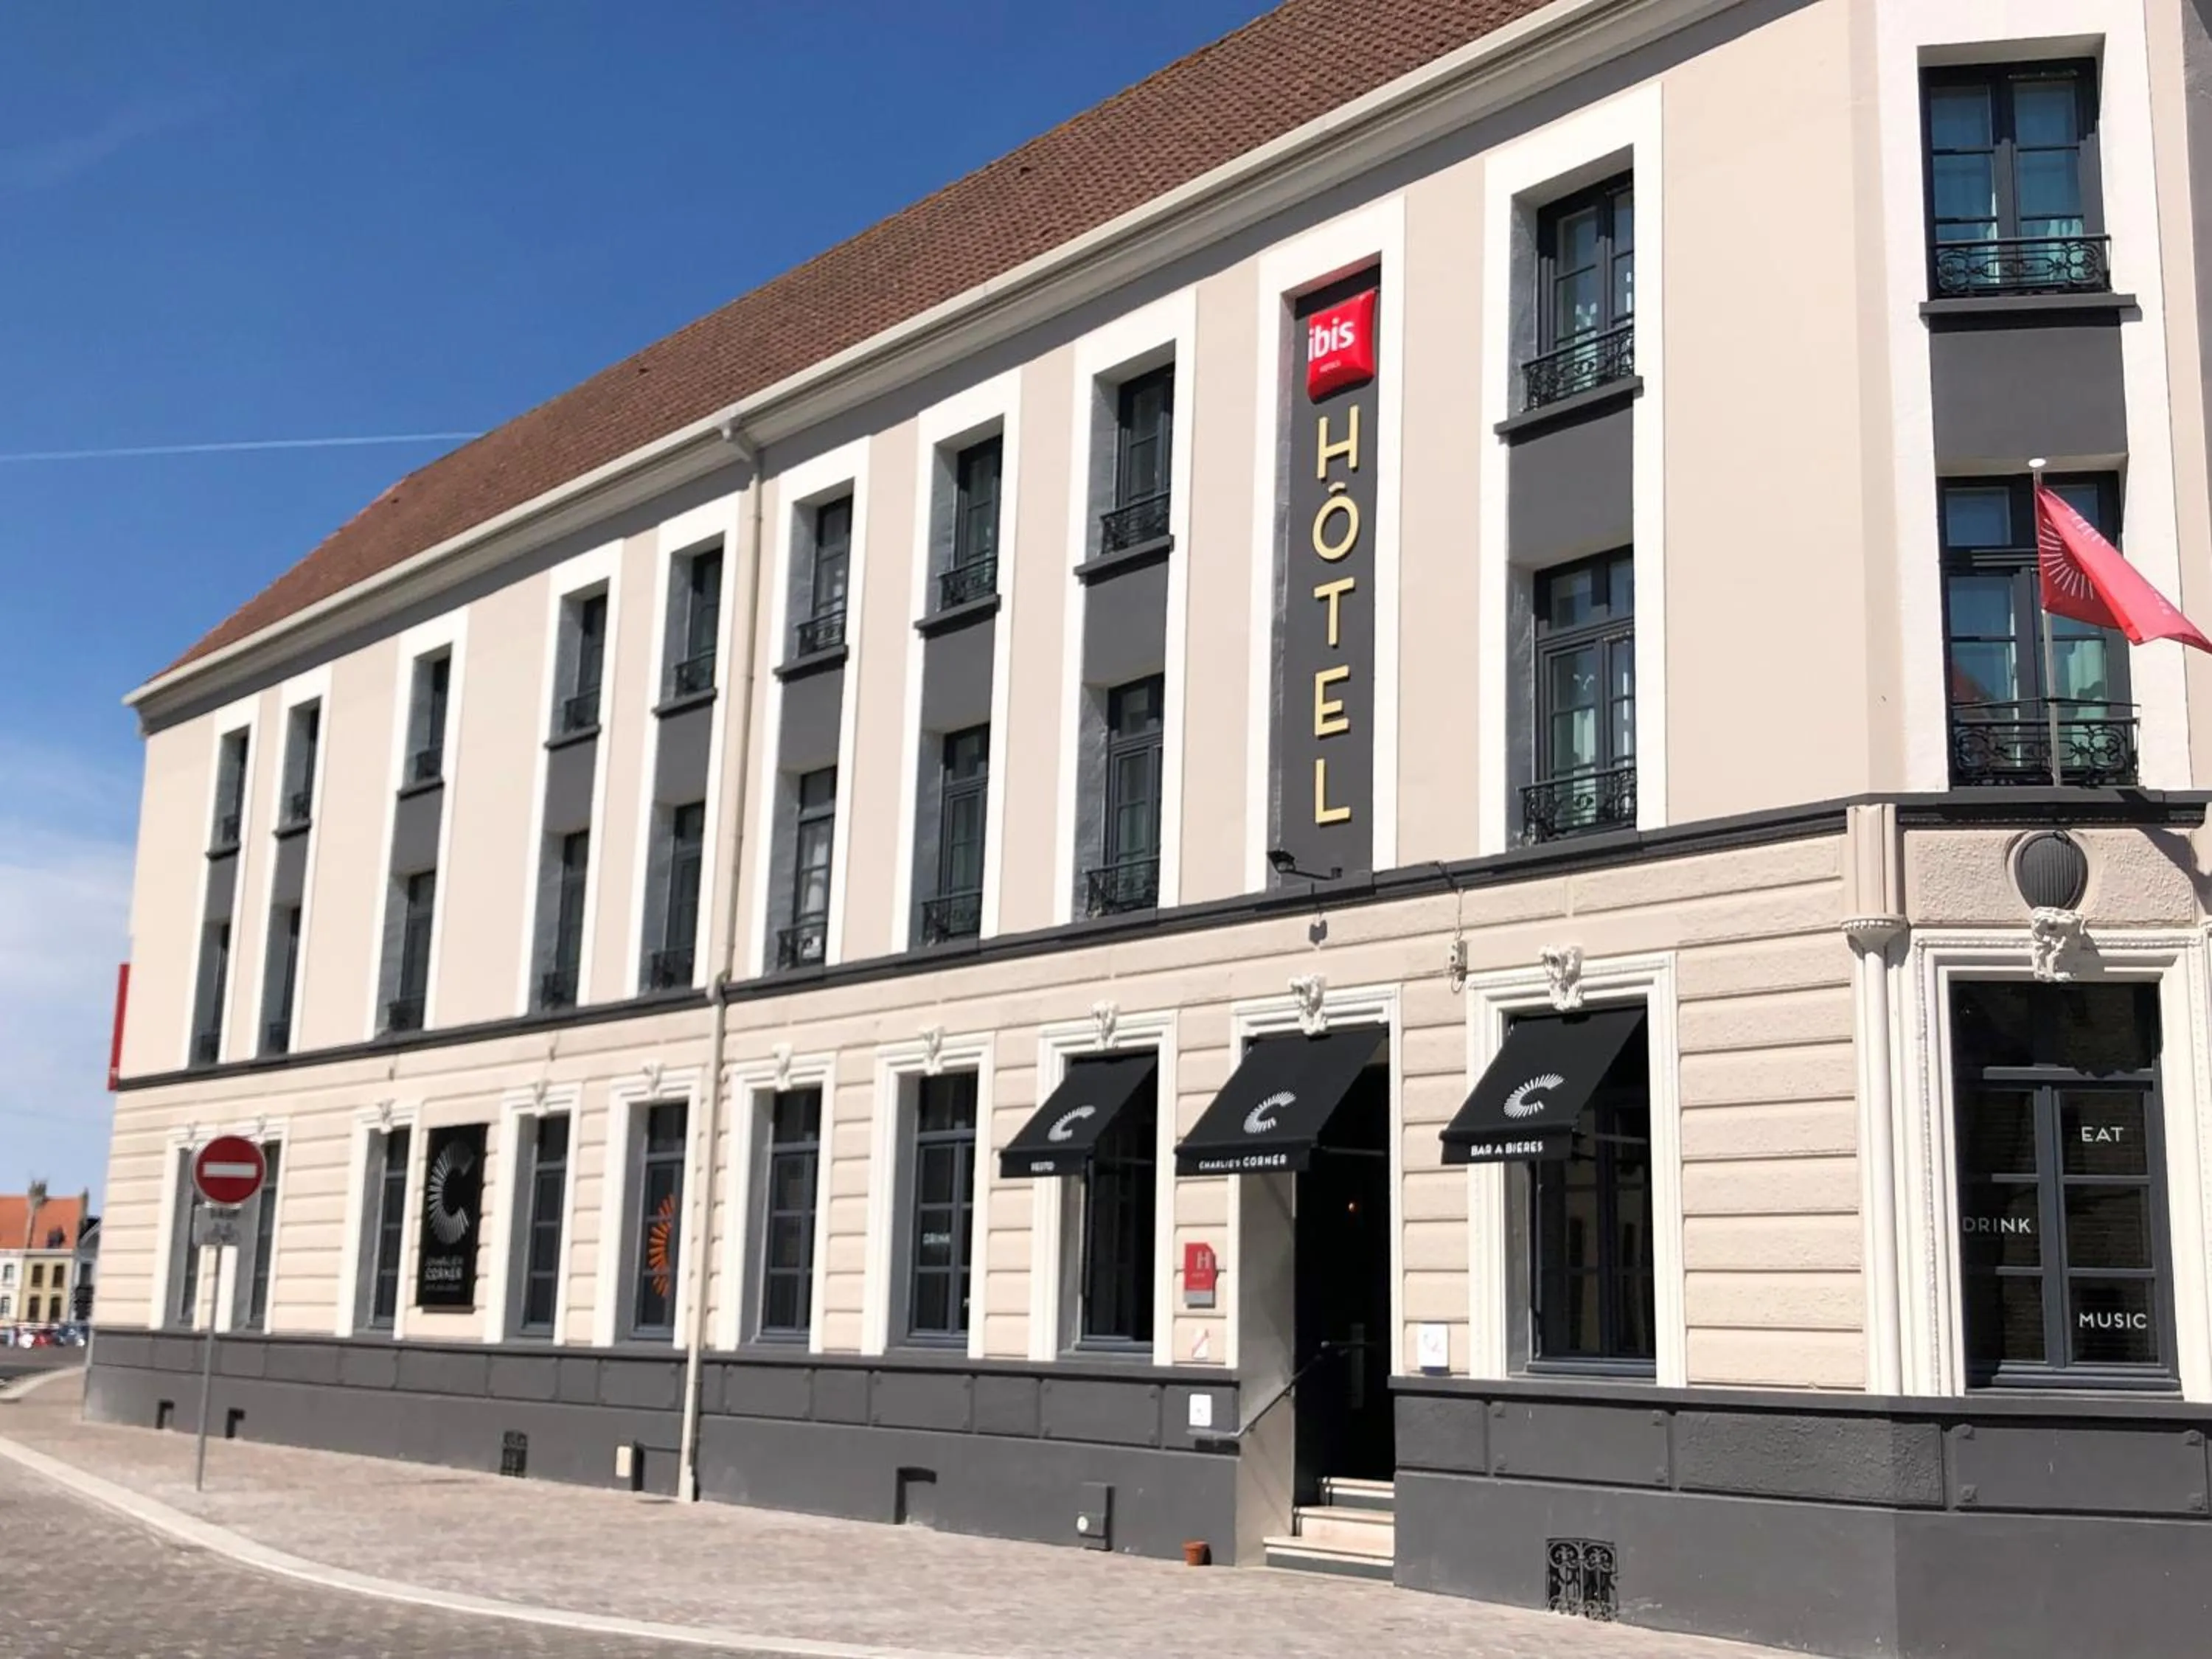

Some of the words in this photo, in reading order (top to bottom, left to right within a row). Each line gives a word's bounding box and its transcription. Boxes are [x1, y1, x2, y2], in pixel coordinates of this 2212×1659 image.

[1308, 318, 1355, 362] ibis
[1312, 404, 1359, 824] HÔTEL
[2081, 1126, 2124, 1142] EAT
[1470, 1144, 1492, 1156] BAR
[1242, 1153, 1287, 1167] CORNER
[1962, 1217, 2031, 1234] DRINK
[2079, 1312, 2147, 1329] MUSIC
